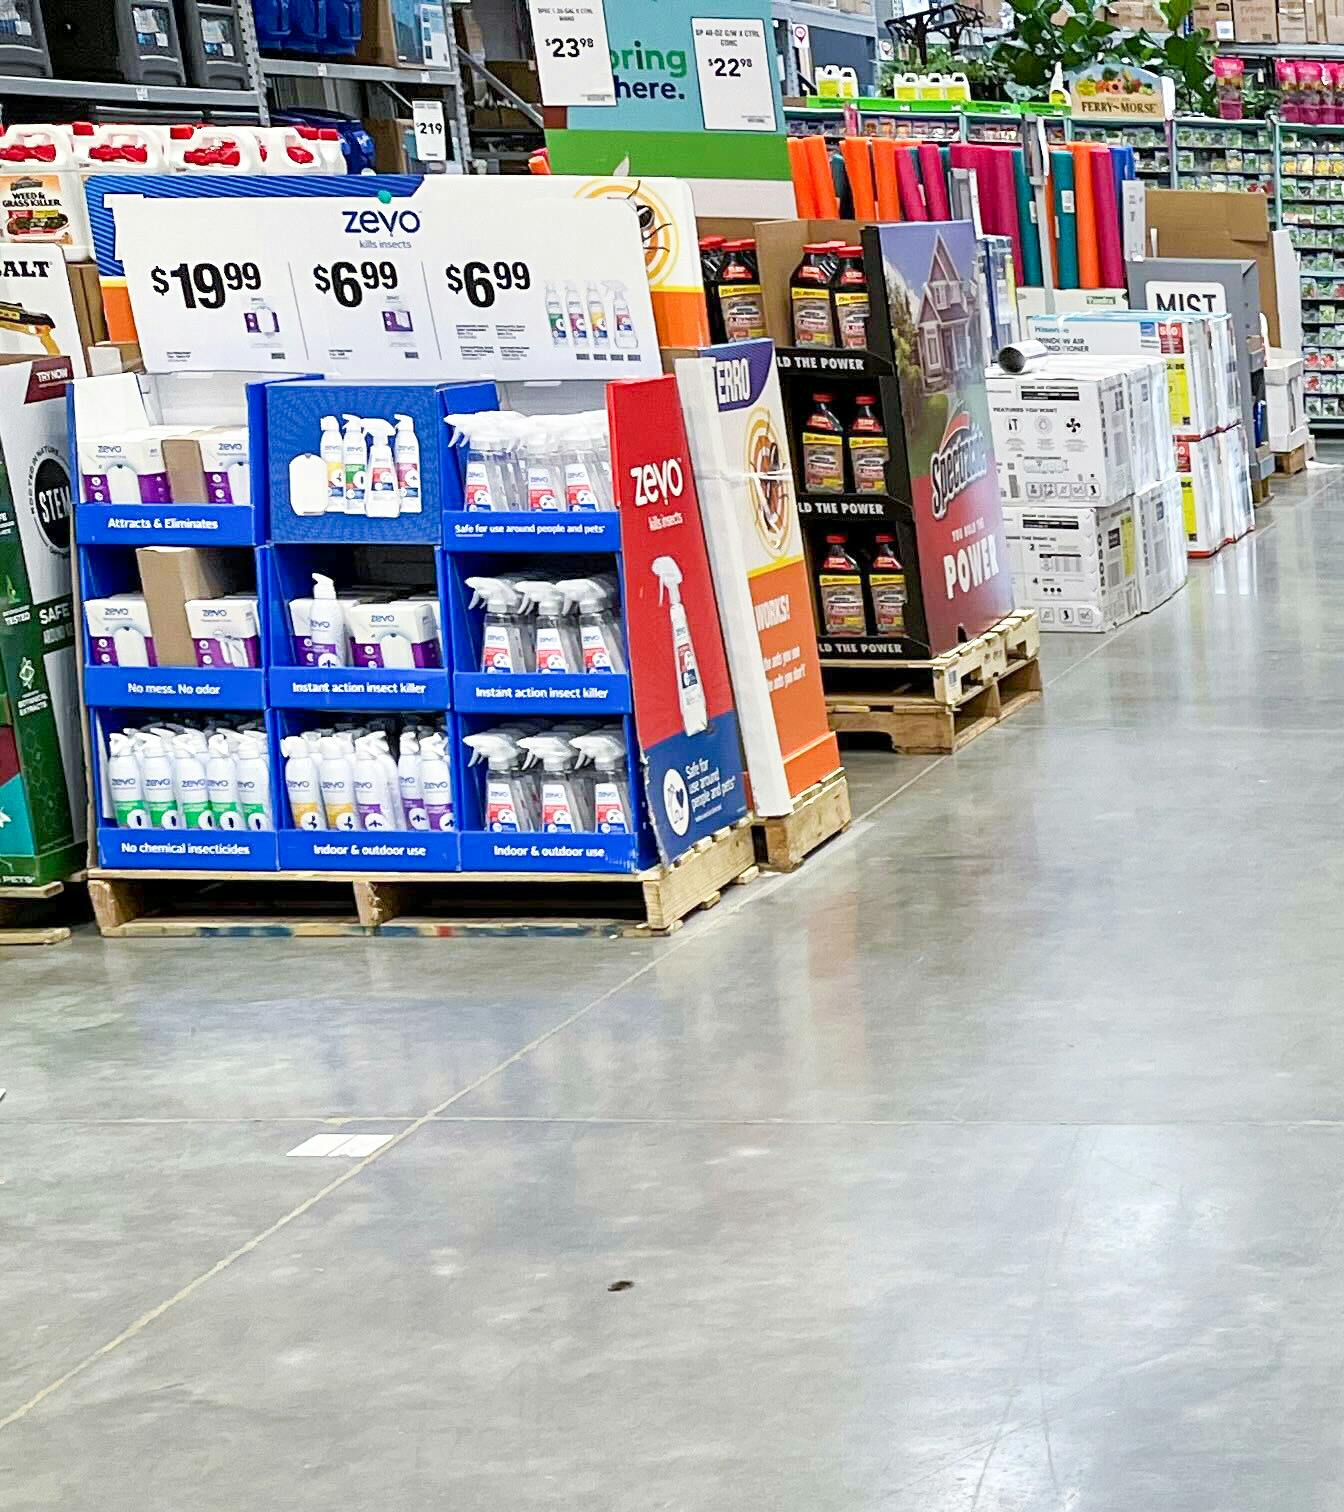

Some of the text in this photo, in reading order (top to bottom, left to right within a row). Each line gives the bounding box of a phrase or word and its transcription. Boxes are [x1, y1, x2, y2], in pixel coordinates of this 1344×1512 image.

[609, 40, 687, 78] ring
[12, 192, 34, 200] WEED
[31, 198, 62, 207] KILLER
[342, 209, 421, 237] zevo
[378, 239, 412, 249] insects
[0, 261, 49, 278] ALT
[1156, 293, 1216, 313] MIST
[794, 357, 864, 371] THE POWER
[631, 458, 682, 506] zevo
[817, 503, 884, 515] THE POWER
[108, 518, 218, 529] Attracts & Eliminates
[455, 525, 477, 534] Safe
[478, 525, 487, 533] for
[506, 525, 535, 533] around
[537, 526, 565, 535] people
[566, 525, 582, 533] and
[943, 533, 999, 600] POWER
[39, 602, 71, 626] SAFE
[835, 643, 902, 653] THE POWER
[128, 683, 220, 695] No mess. No odor
[293, 682, 426, 694] Instant action insect killer
[476, 688, 608, 698] Instant action insect killer
[122, 843, 250, 855] No chemical insecticides
[314, 845, 426, 857] Indoor & outdoor use
[494, 845, 604, 857] Indoor & outdoor use
